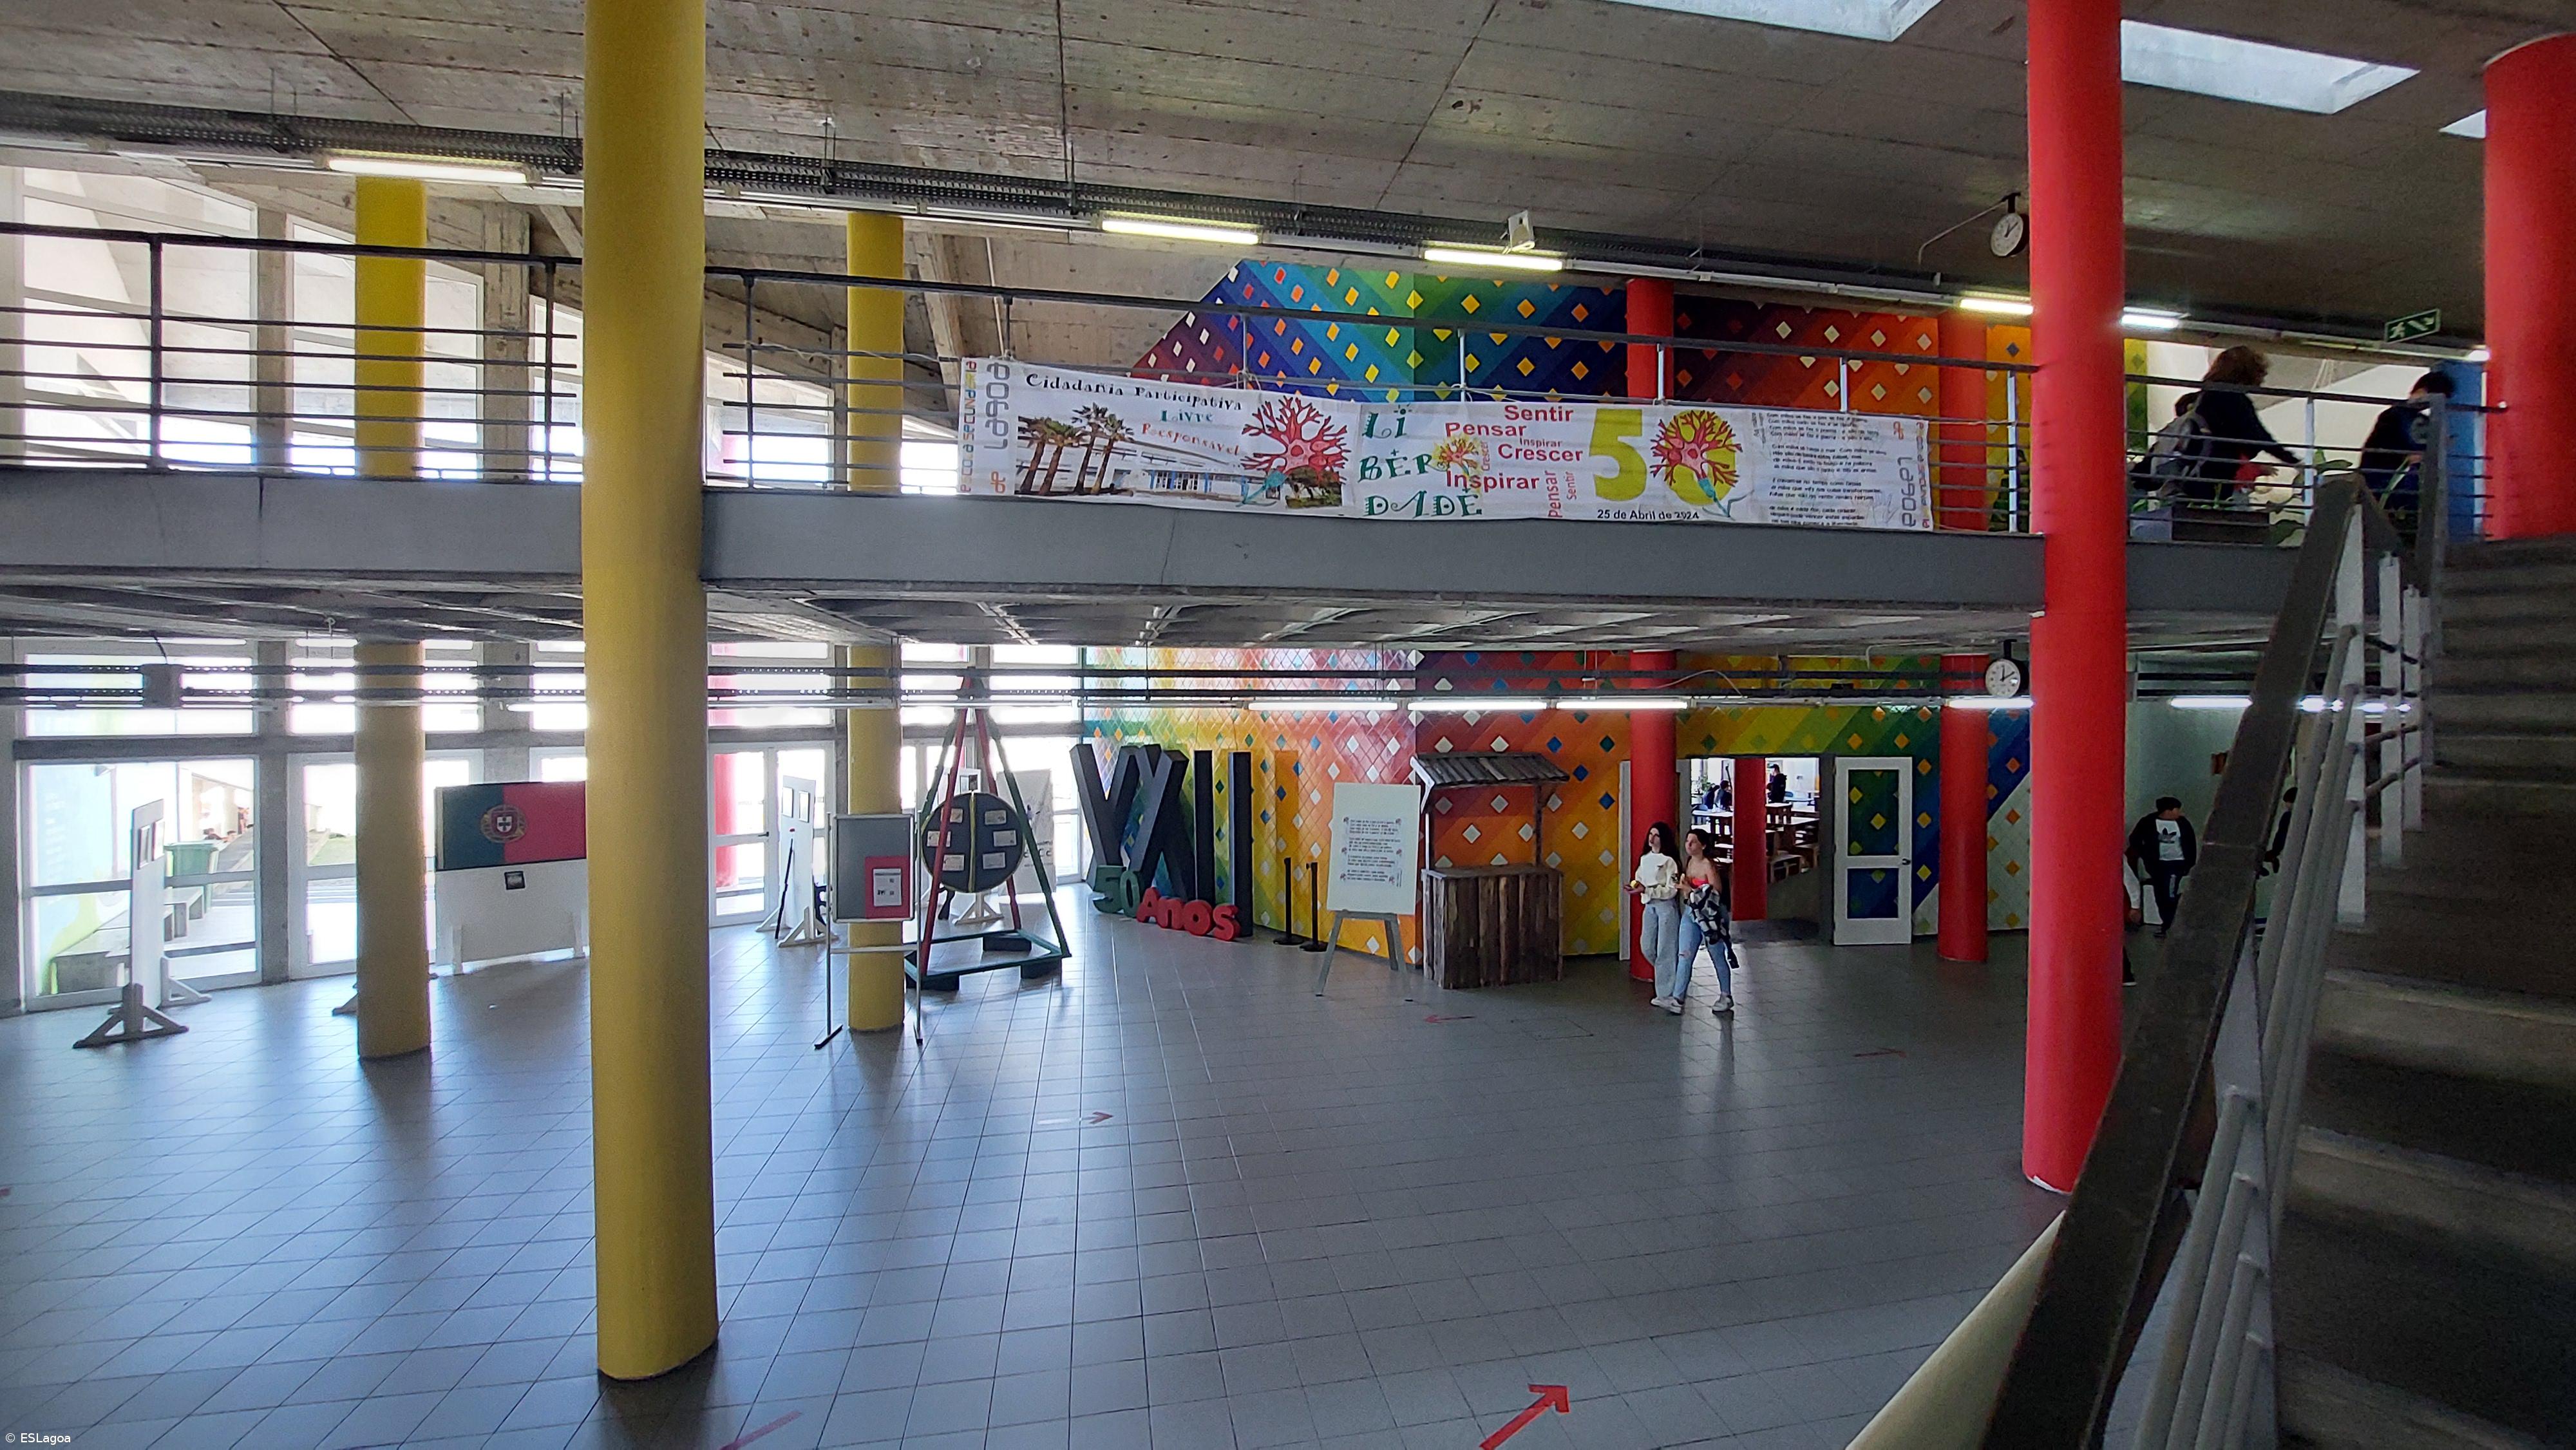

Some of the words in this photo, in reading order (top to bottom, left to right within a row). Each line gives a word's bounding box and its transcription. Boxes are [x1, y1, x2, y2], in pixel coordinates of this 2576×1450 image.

[1026, 373, 1123, 396] Cidadania
[1135, 386, 1242, 410] Participativa
[983, 362, 1010, 449] Lagoa
[1504, 404, 1575, 422] Sentir
[1160, 410, 1214, 423] Livre
[1445, 422, 1527, 438] Pensar
[1497, 442, 1584, 462] Crescer
[1519, 437, 1563, 448] Inspirar
[1589, 408, 1738, 505] 50
[1446, 470, 1540, 493] Inspirar
[1897, 457, 1917, 527] Lagoa
[1597, 509, 1611, 520] 25
[1613, 509, 1626, 520] de
[1629, 509, 1656, 520] Abril
[1658, 511, 1672, 520] de
[1092, 864, 1141, 918] 50
